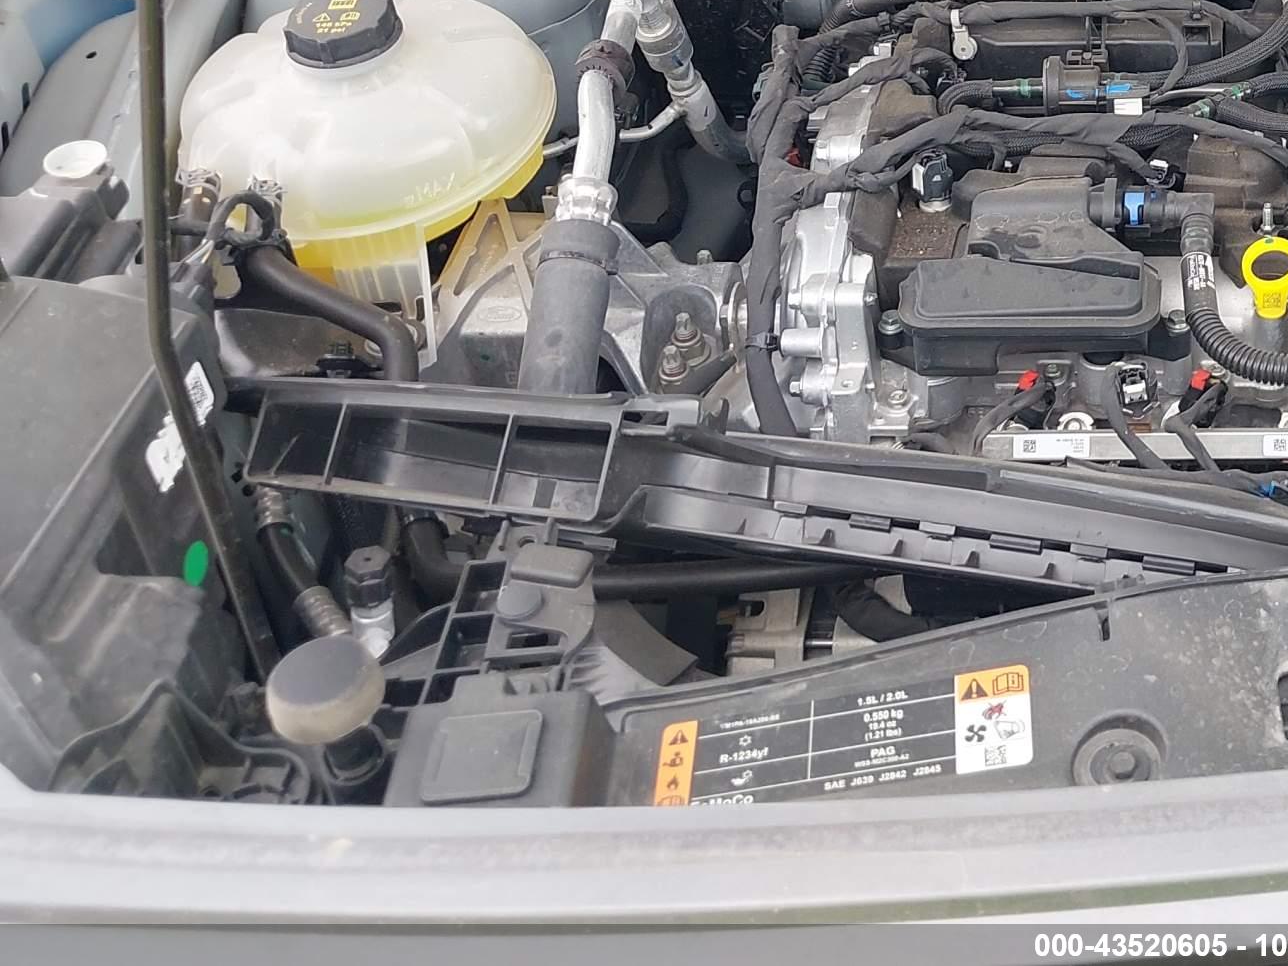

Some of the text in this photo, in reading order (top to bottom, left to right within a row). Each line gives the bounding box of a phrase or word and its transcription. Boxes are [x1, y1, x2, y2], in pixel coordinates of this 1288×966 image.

[857, 696, 879, 706] 1.5L
[886, 690, 908, 702] 2.0L
[863, 709, 904, 722] 0.550 kg
[719, 746, 769, 763] R-1234yf
[870, 745, 896, 758] PAG
[824, 764, 942, 791] SAE J639 J2842 J2845
